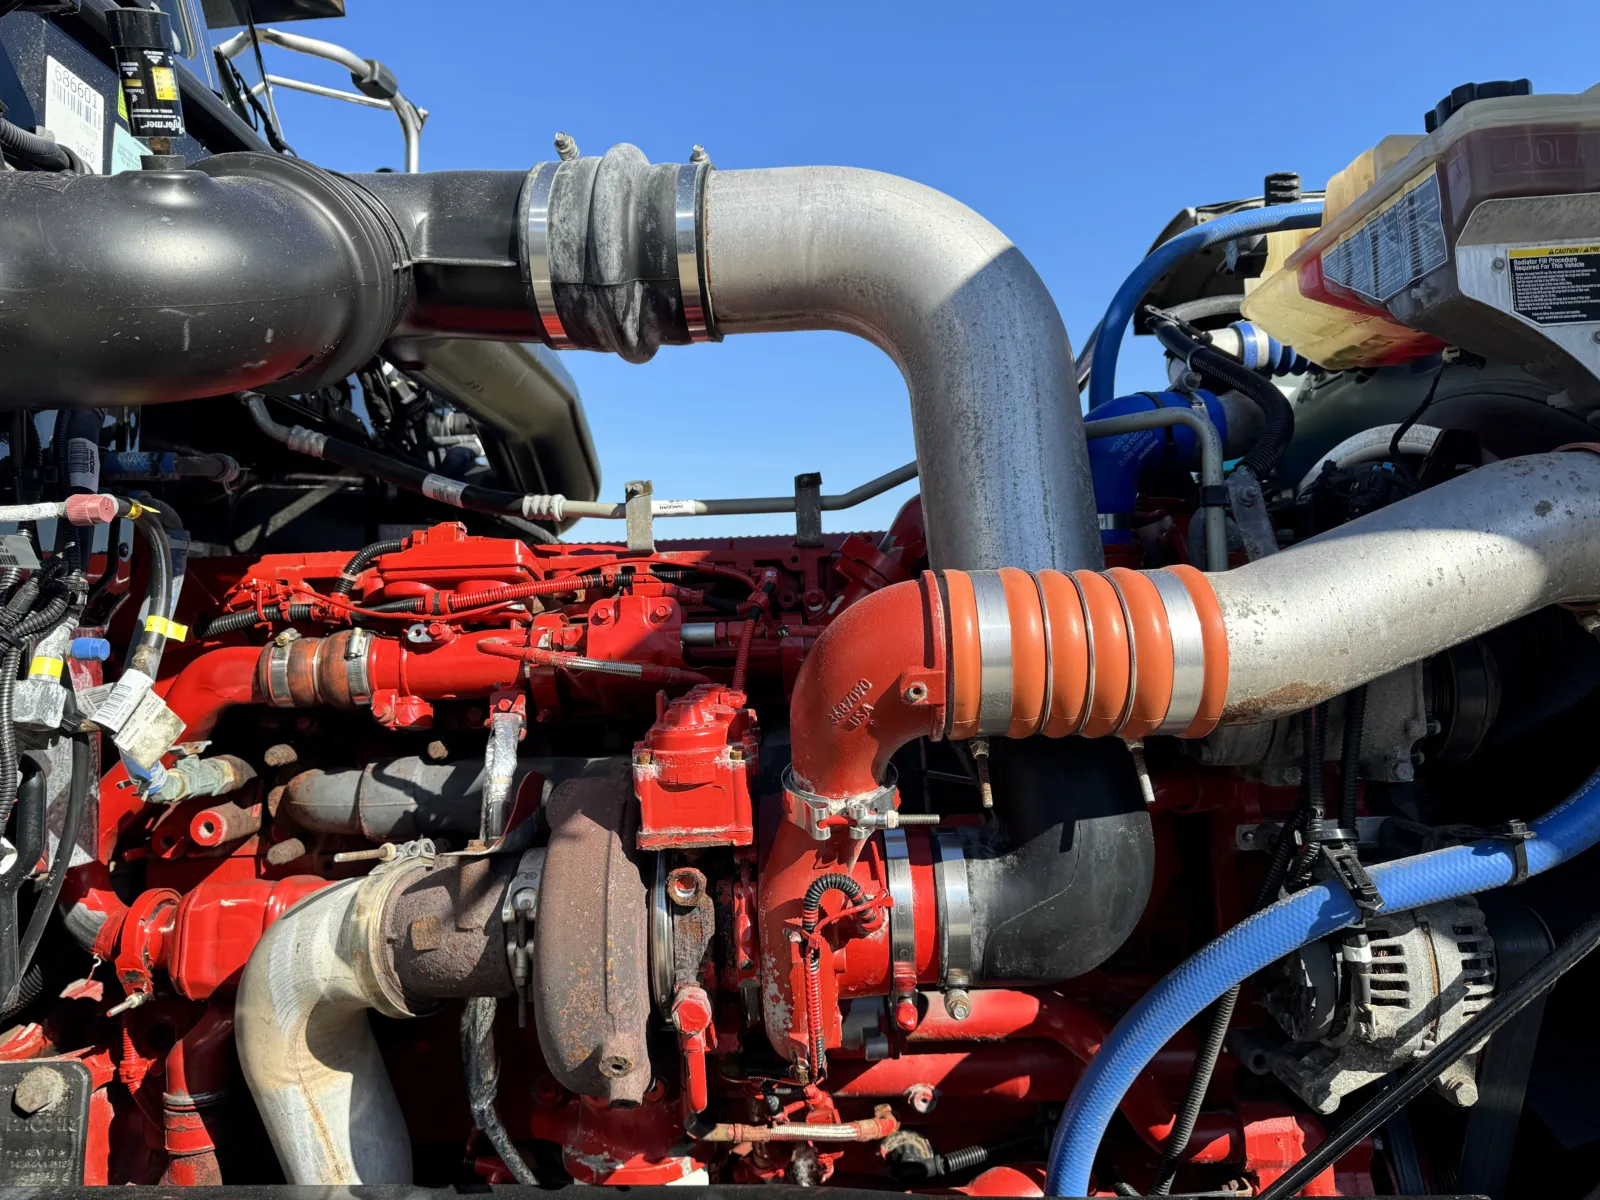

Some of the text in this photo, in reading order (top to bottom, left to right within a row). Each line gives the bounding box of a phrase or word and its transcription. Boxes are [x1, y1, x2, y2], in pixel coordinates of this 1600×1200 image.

[55, 65, 98, 109] 686601
[1554, 247, 1580, 255] CAUTION
[849, 703, 875, 726] USA
